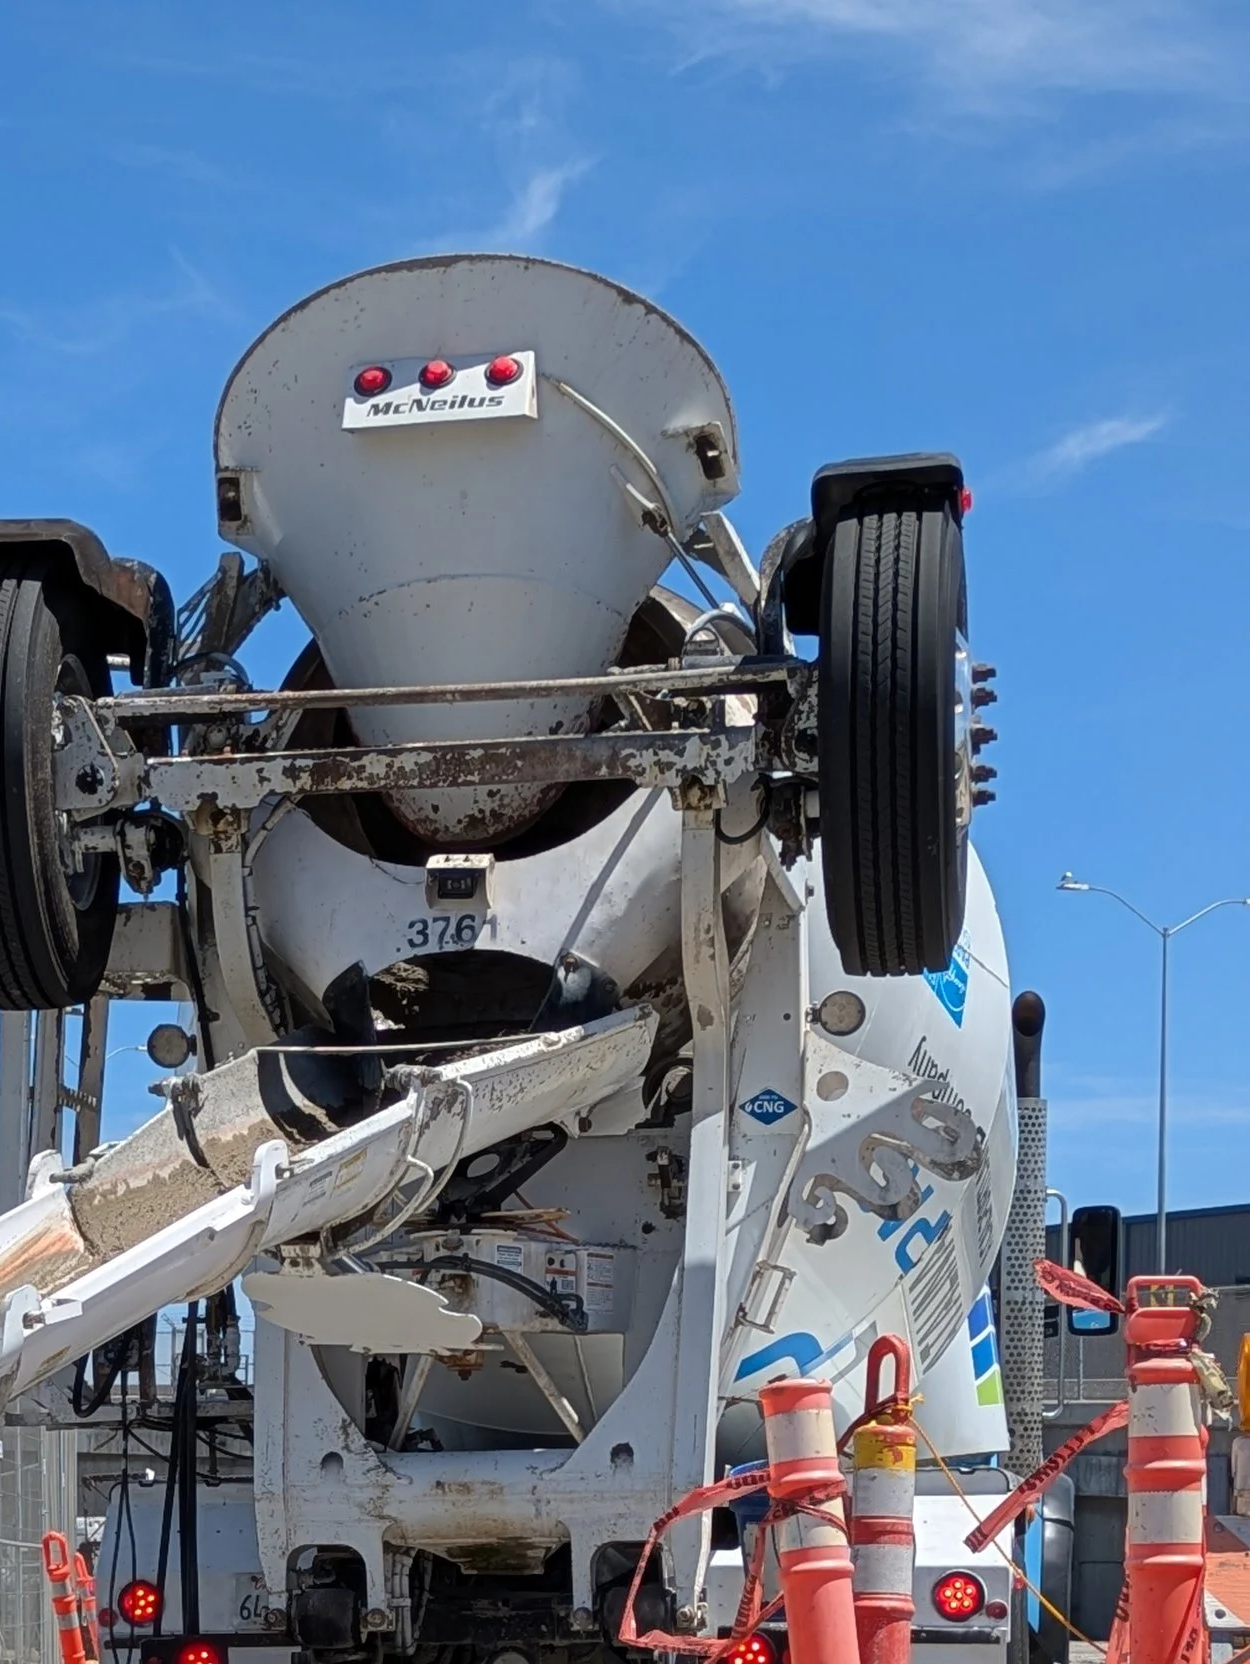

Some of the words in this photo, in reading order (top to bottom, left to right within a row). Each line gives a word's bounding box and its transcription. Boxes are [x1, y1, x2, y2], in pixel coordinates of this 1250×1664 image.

[366, 394, 505, 418] McNeilus
[406, 913, 499, 950] 3761
[753, 1100, 785, 1114] CNG
